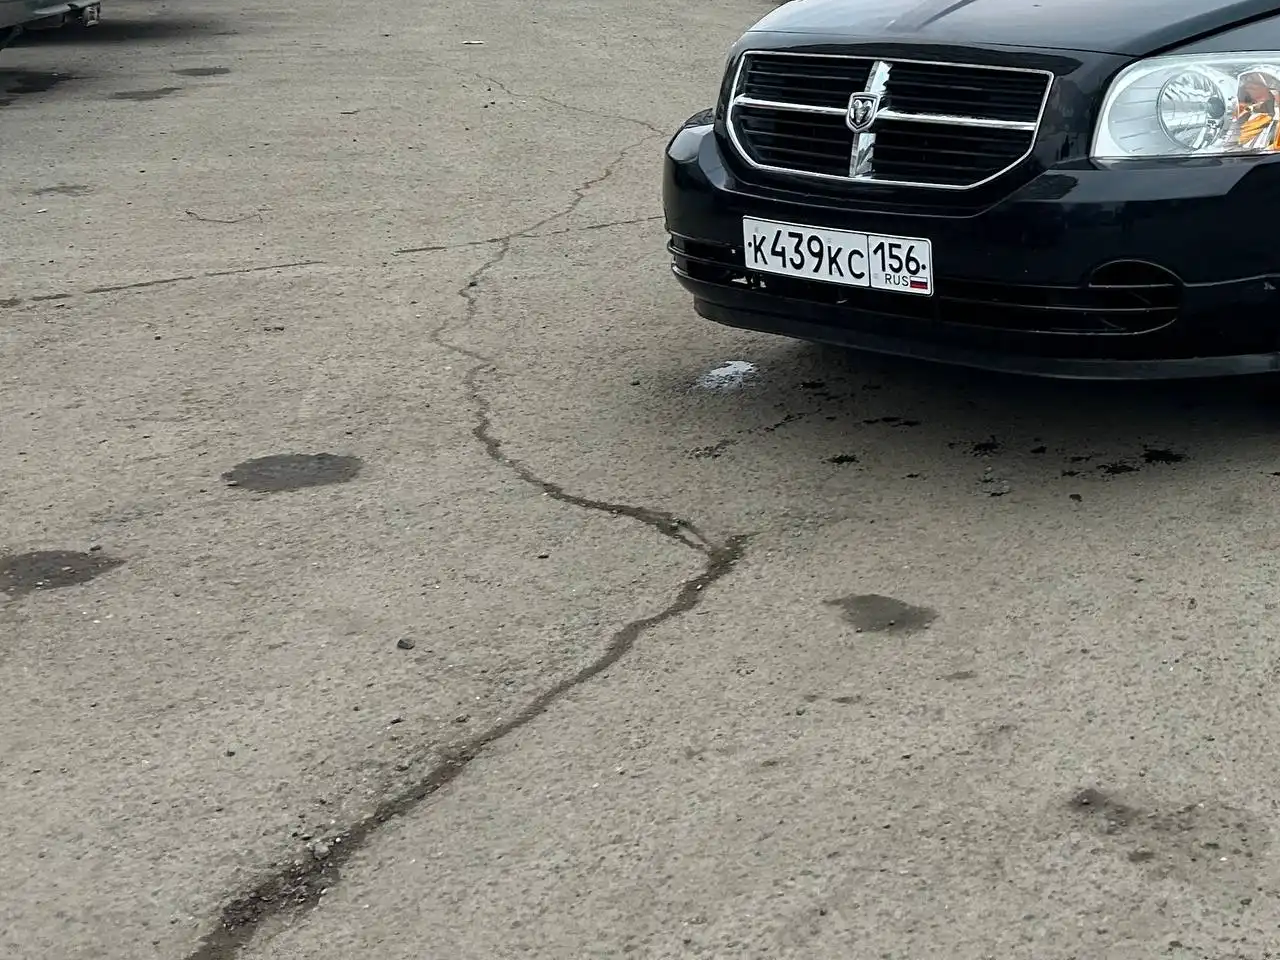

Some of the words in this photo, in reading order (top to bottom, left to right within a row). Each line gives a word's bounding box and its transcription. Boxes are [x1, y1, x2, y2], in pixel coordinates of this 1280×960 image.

[752, 229, 865, 280] К439КС
[872, 241, 921, 275] 156
[884, 273, 909, 287] RUS
